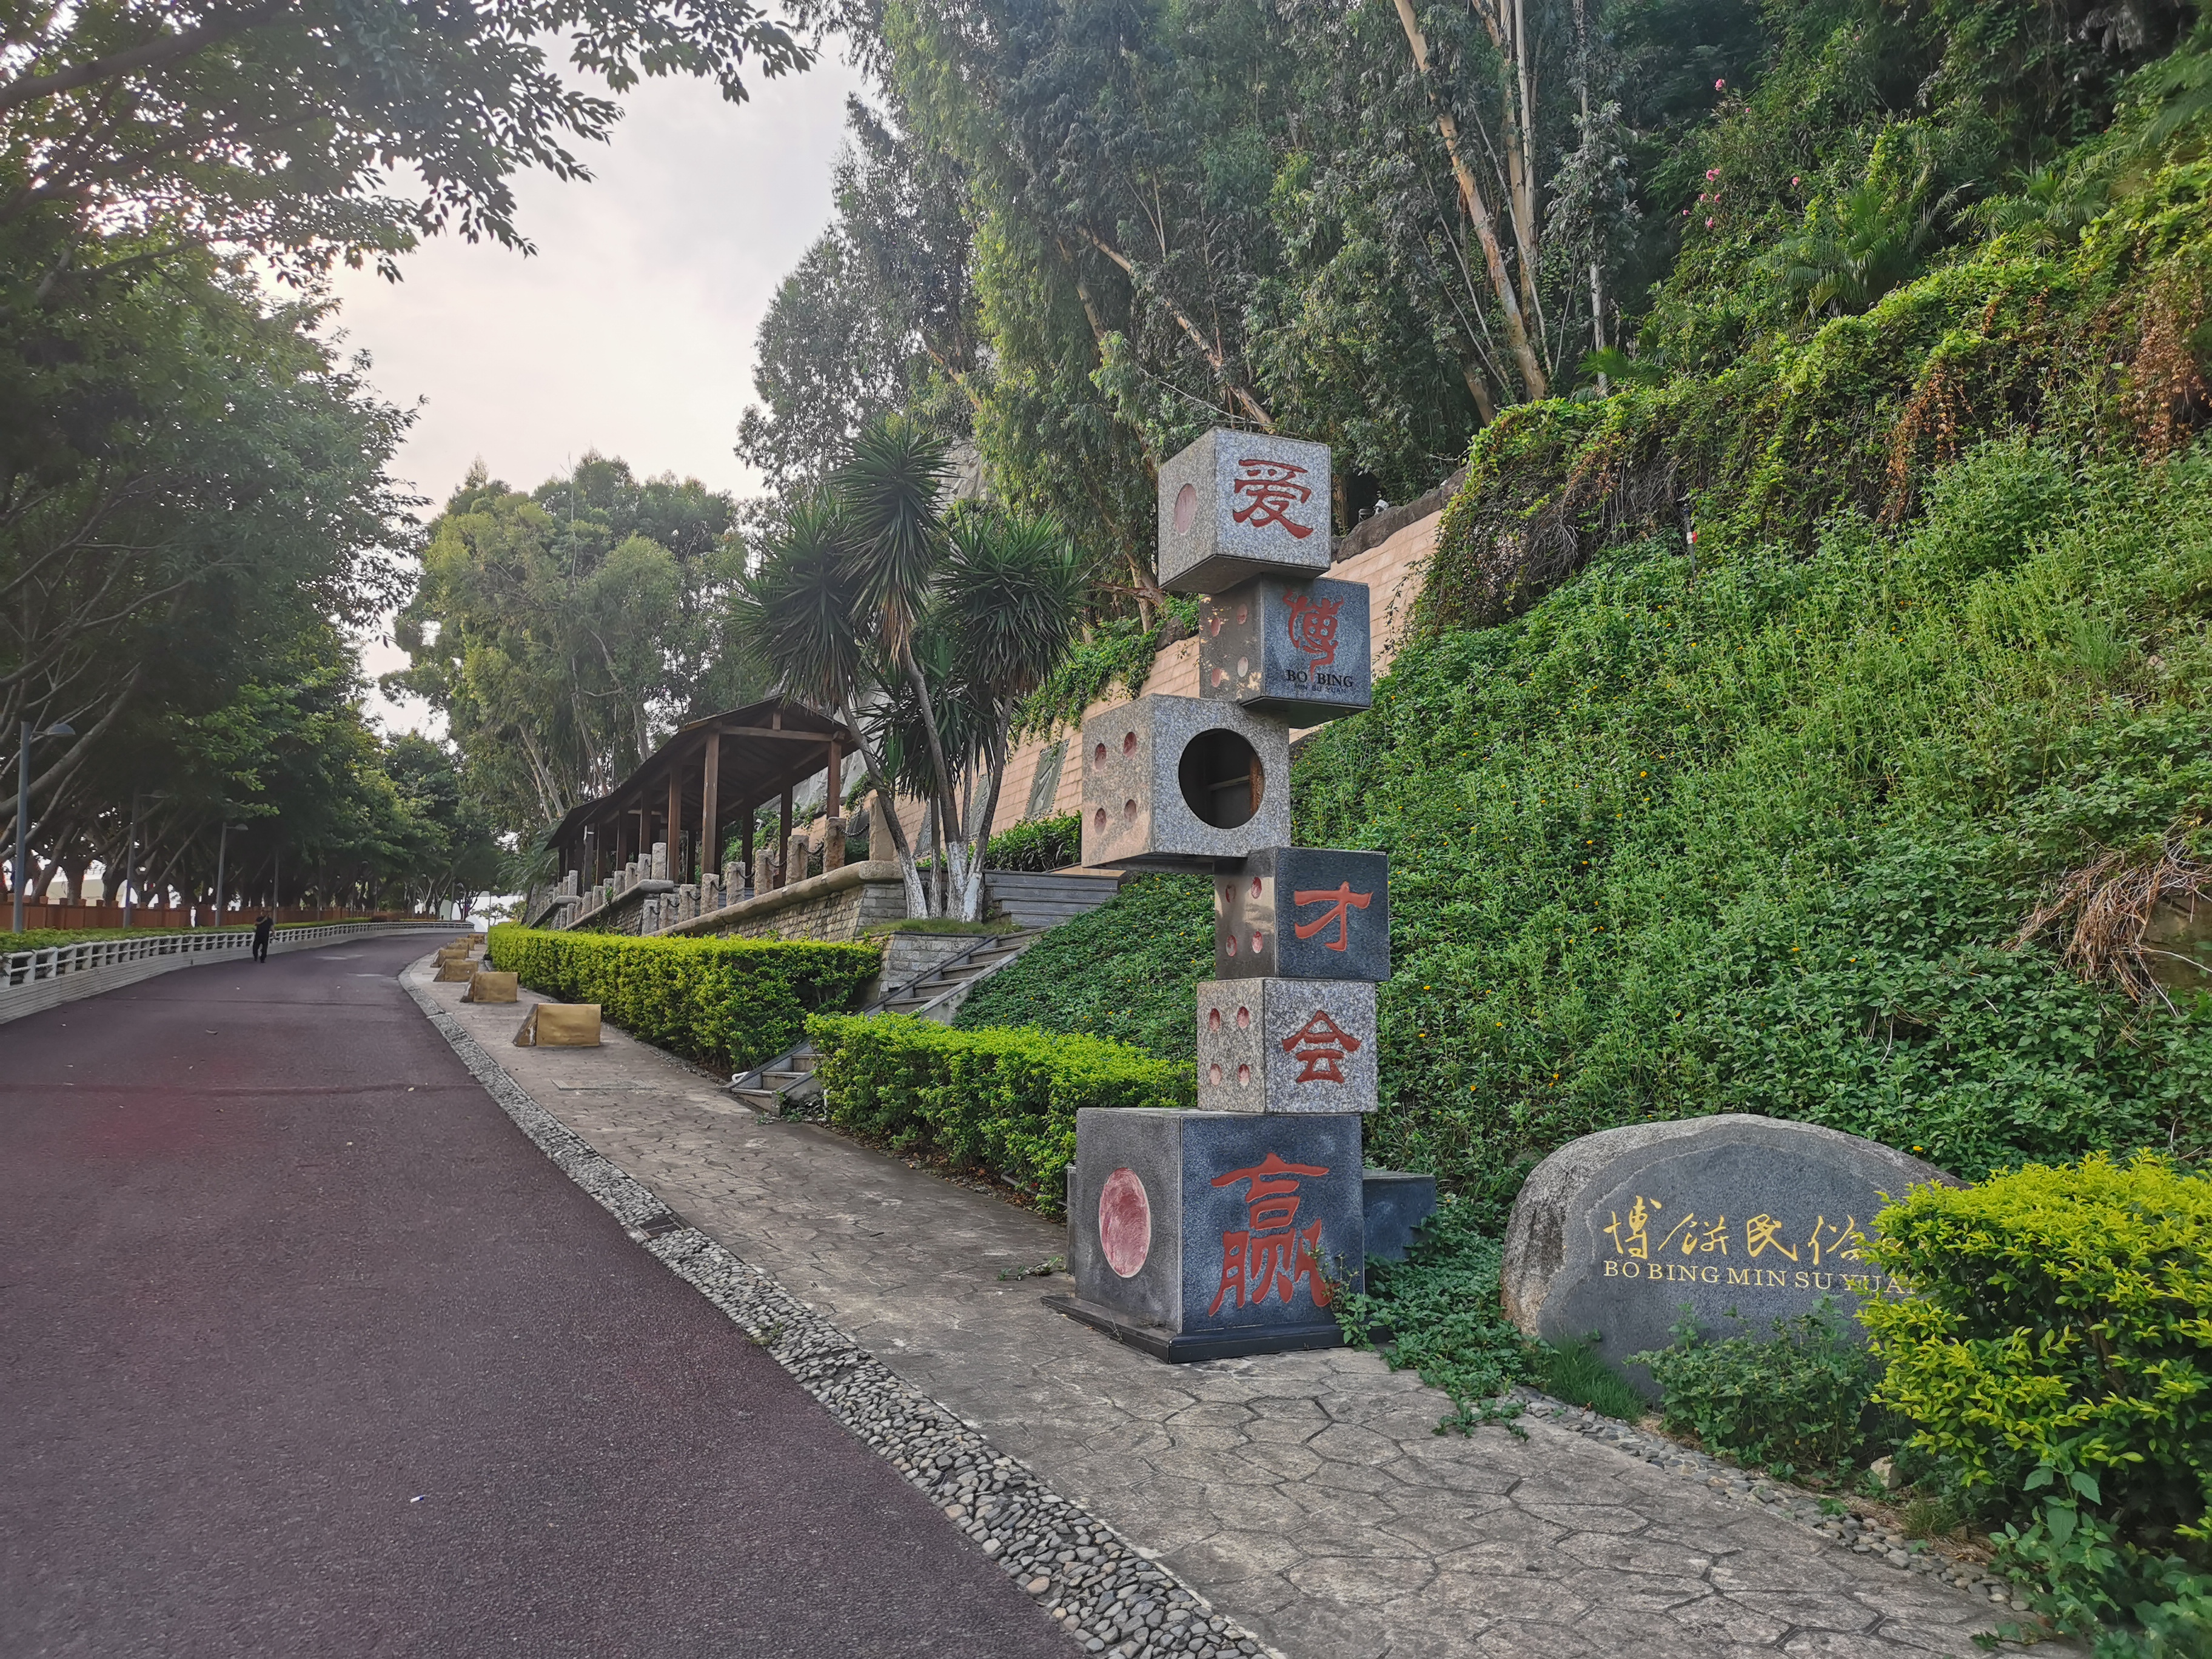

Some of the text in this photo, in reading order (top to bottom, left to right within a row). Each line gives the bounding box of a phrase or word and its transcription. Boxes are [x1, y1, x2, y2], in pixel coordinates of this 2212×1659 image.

[1232, 458, 1314, 540] 爱
[1286, 669, 1353, 687] BO BING
[1293, 880, 1373, 951] 才
[1281, 1010, 1362, 1084] 会
[1208, 1152, 1340, 1317] 赢
[1603, 1195, 1905, 1267] 博饼民俗
[1603, 1260, 1640, 1278] BO
[1647, 1263, 1720, 1284] BING
[1726, 1267, 1788, 1287] MIN
[1794, 1271, 1834, 1290] SU
